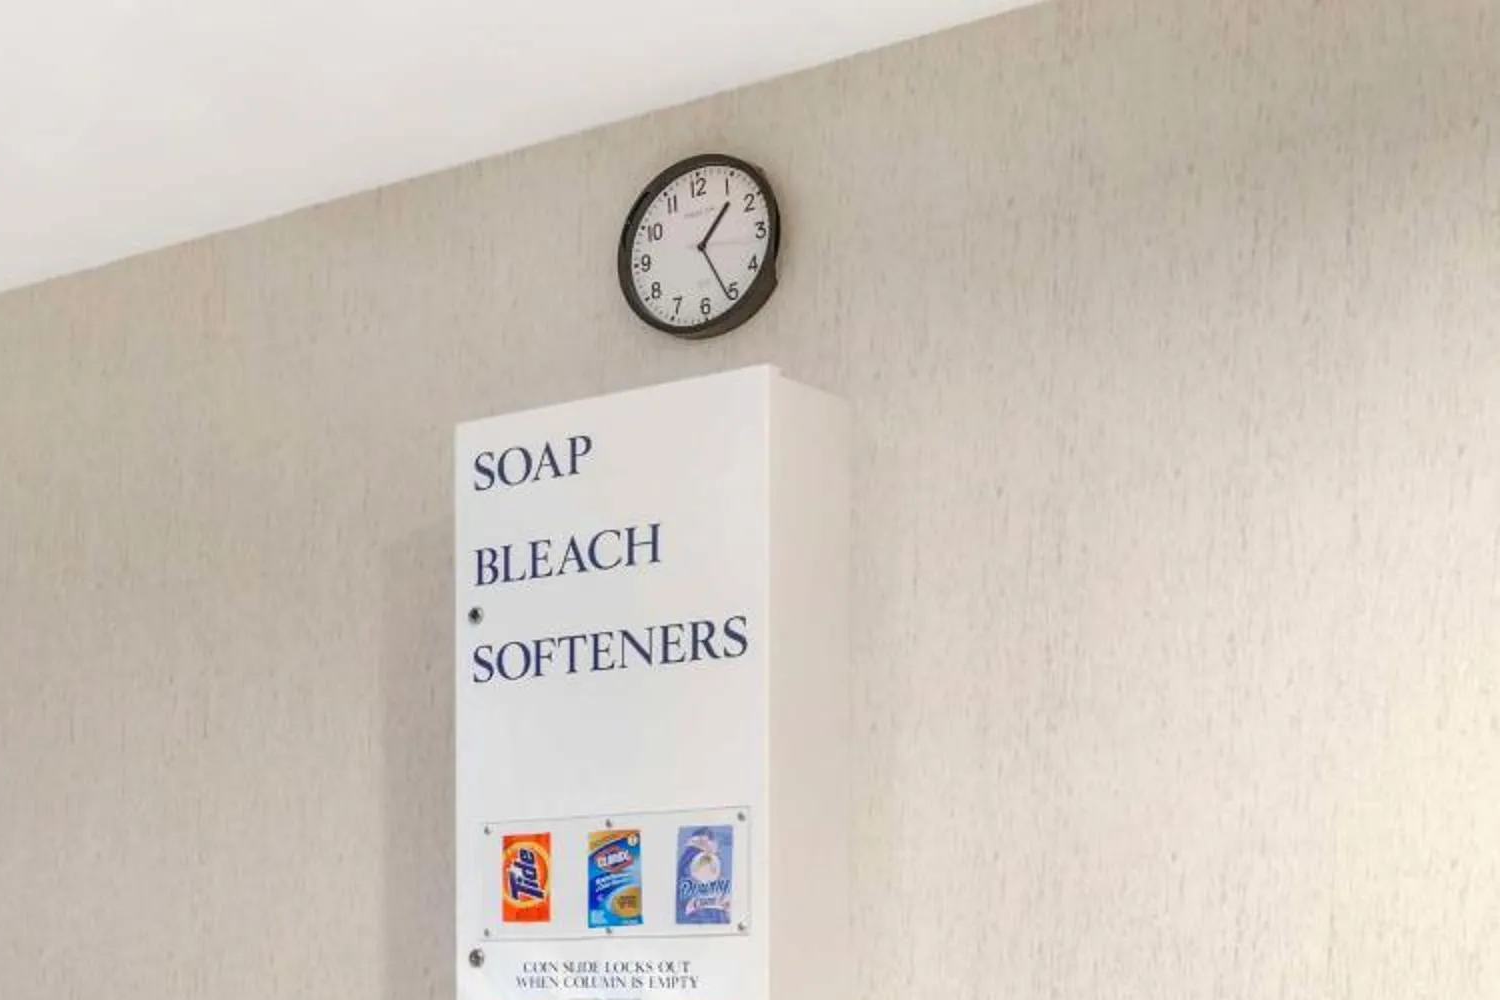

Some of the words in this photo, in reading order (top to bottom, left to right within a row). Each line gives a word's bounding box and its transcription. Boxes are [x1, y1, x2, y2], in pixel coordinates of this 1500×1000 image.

[690, 177, 707, 198] 12
[725, 178, 730, 197] 1
[667, 195, 679, 214] 11
[743, 193, 756, 213] 2
[647, 223, 663, 242] 10
[755, 221, 767, 239] 3
[641, 254, 651, 272] 9
[747, 255, 758, 272] 4
[651, 282, 662, 299] 8
[728, 282, 739, 300] 5
[673, 296, 683, 315] 7
[700, 298, 711, 315] 6
[473, 435, 593, 491] SOAP
[474, 523, 661, 586] BLEACH
[472, 615, 748, 683] SOFTENERS
[508, 848, 545, 900] Tide
[522, 960, 558, 973] COIN
[563, 960, 600, 973] SLIDE
[605, 960, 653, 973] LOCKS
[657, 960, 691, 973] OUT
[516, 976, 558, 989] WHEN
[563, 976, 627, 989] COLUMN
[631, 976, 644, 989] IS
[649, 976, 699, 989] EMPTY
